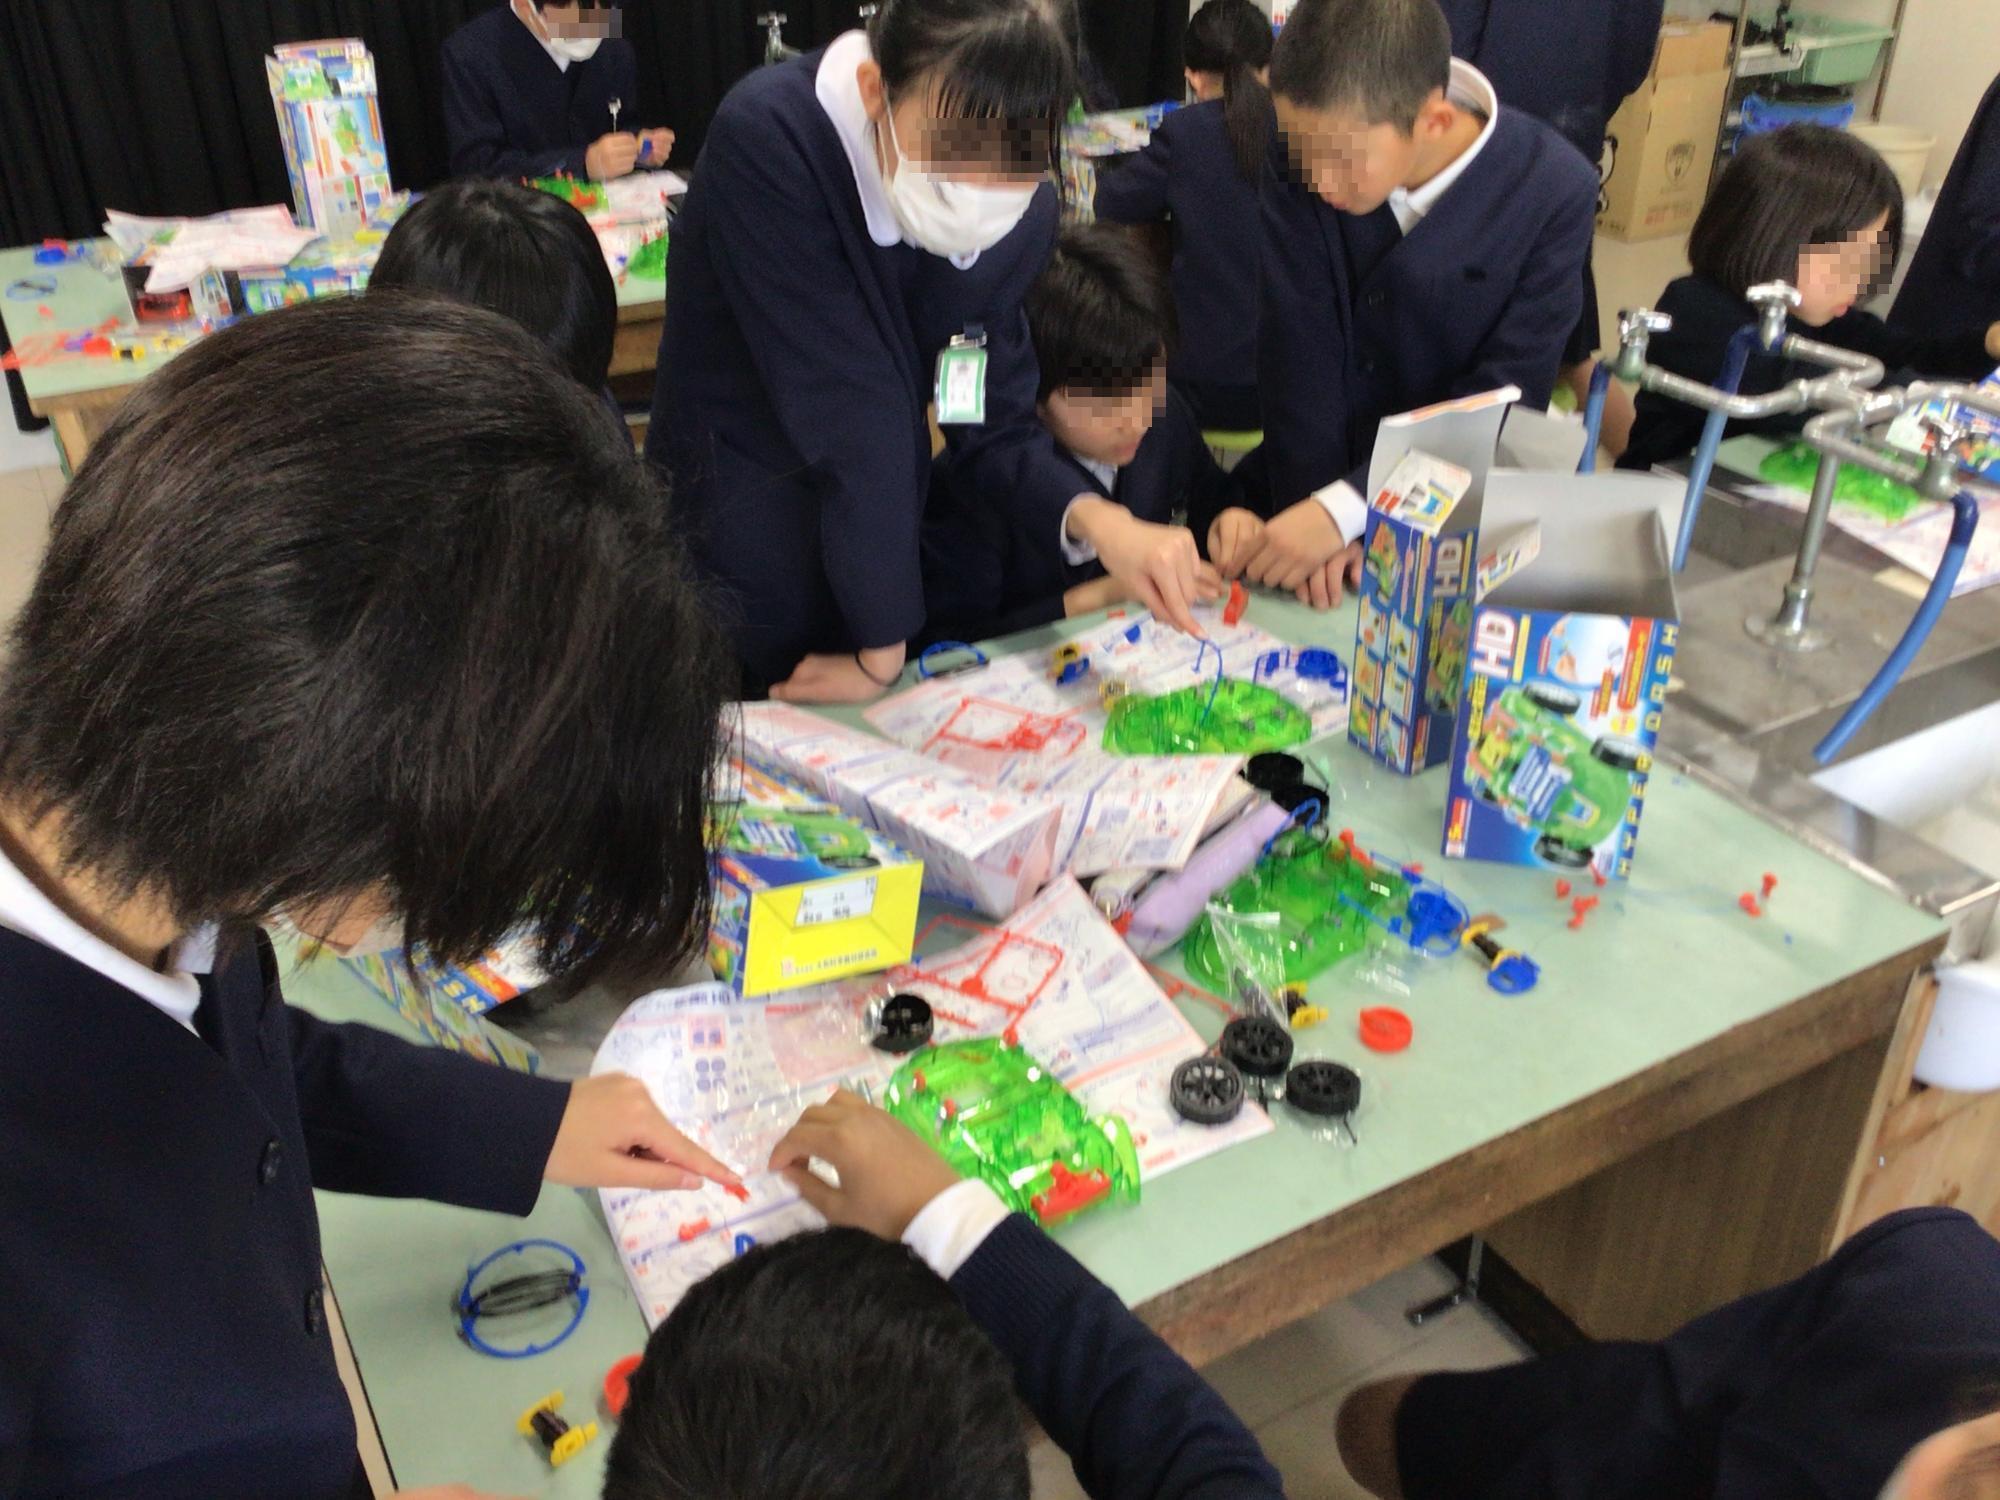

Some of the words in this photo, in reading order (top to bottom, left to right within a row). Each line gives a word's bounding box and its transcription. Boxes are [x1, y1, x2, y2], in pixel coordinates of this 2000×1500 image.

[1433, 537, 1463, 597] HD
[1471, 609, 1517, 679] HD
[1644, 623, 1679, 732] DASH
